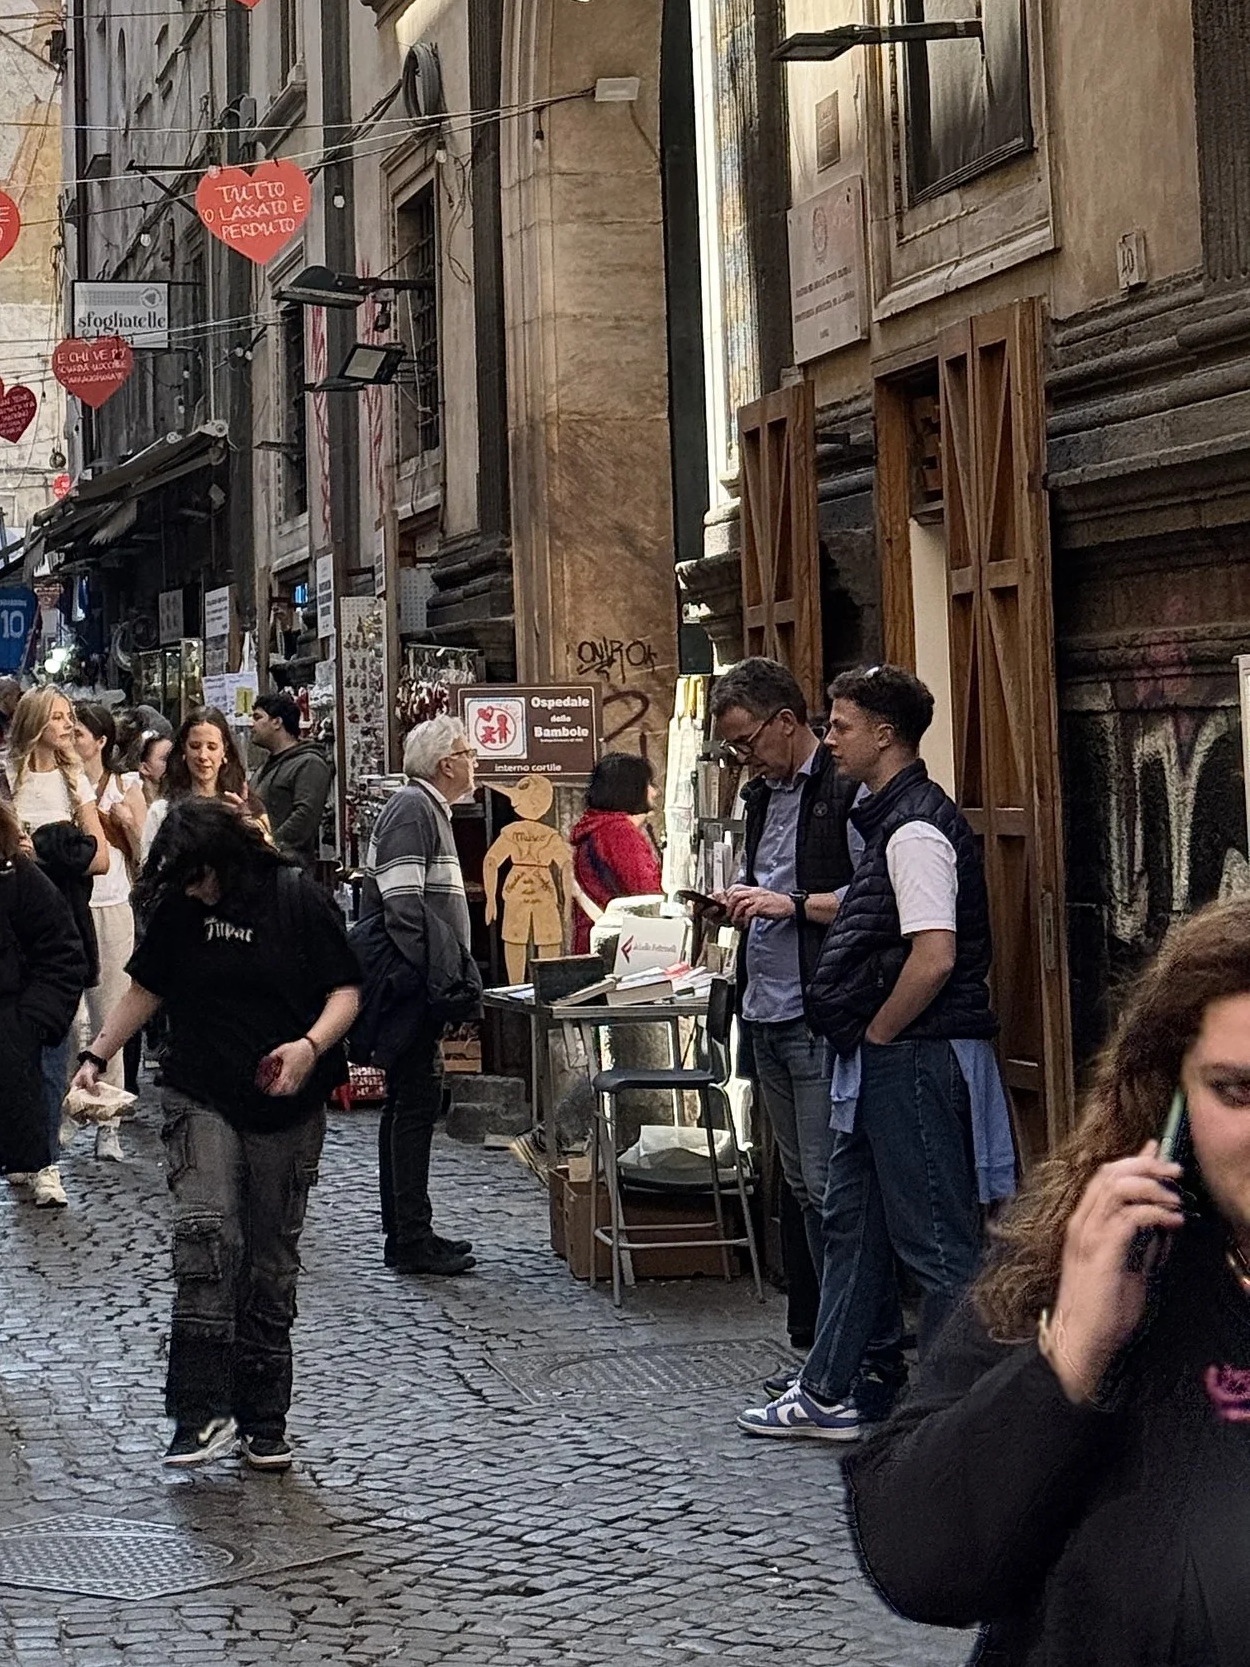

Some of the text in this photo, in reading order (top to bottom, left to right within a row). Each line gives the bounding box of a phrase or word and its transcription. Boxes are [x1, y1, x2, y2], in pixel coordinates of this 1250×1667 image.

[215, 181, 284, 203] TUTTO
[220, 200, 287, 221] LASSATO
[222, 218, 295, 240] PERDUTO
[78, 311, 166, 332] sfogliatelle
[0, 610, 25, 638] 10
[531, 696, 590, 710] Ospedale
[534, 726, 589, 738] Bambole
[494, 763, 562, 772] interno cortile
